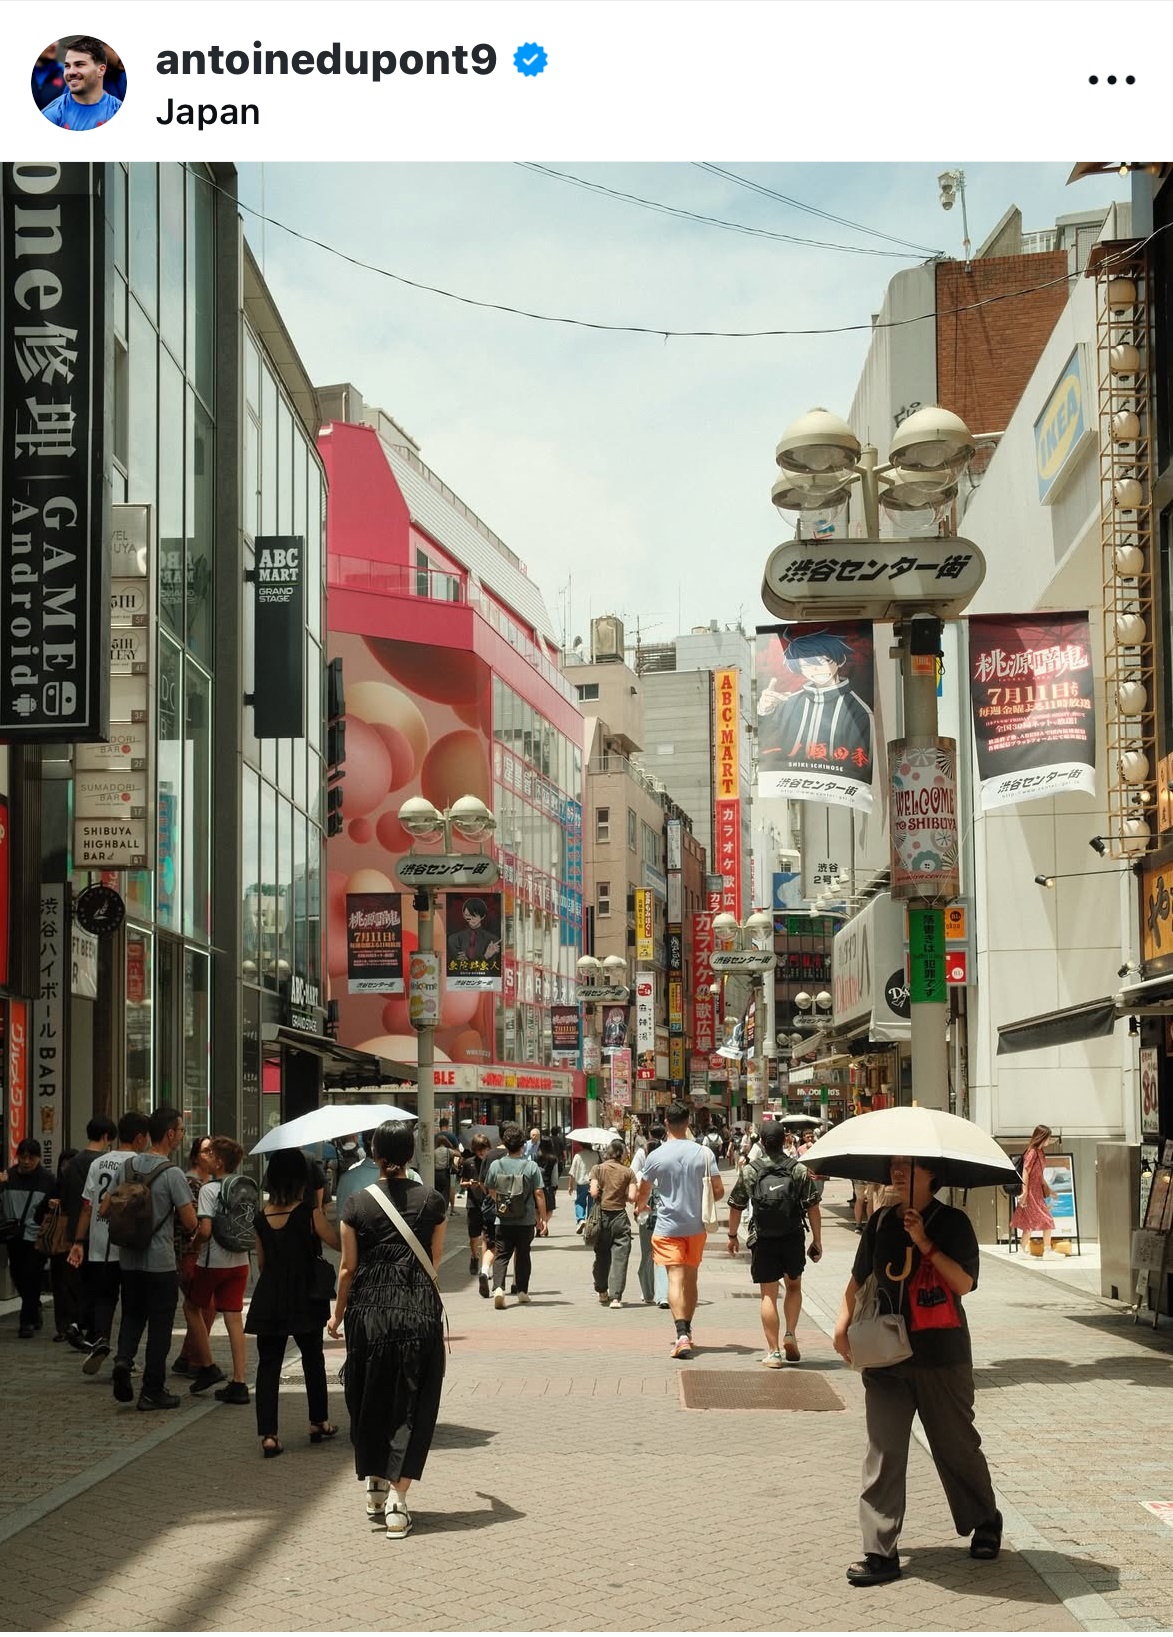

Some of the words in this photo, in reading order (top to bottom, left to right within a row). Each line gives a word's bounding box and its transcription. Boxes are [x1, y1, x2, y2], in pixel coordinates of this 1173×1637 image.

[1040, 384, 1079, 469] IKEA
[258, 548, 299, 568] ABC
[258, 568, 299, 582] MART
[778, 554, 973, 583] 渋谷センター街
[42, 496, 78, 673] GAME
[258, 587, 294, 595] GRAND
[11, 498, 40, 687] Android
[258, 595, 290, 603] STAGE
[974, 643, 1089, 682] 桃源暗鬼
[99, 745, 120, 753] BAR
[134, 760, 144, 768] 2F
[810, 762, 843, 771] ICHINOSE
[776, 777, 859, 797] 渋谷センター街
[997, 768, 1083, 794] 渋谷センター街
[895, 787, 954, 817] WELCOME
[908, 817, 957, 831] SHIBUYA
[83, 826, 132, 836] SHIBUYA
[83, 840, 139, 849] HIGHBALL
[83, 852, 105, 861] BAR
[400, 862, 490, 875] 渋谷センター街
[818, 862, 838, 873] 渋谷
[713, 955, 772, 964] 渋谷センター街
[578, 988, 624, 997] 渋谷センター街
[291, 1015, 305, 1028] GRAND
[305, 1017, 317, 1032] STAGE
